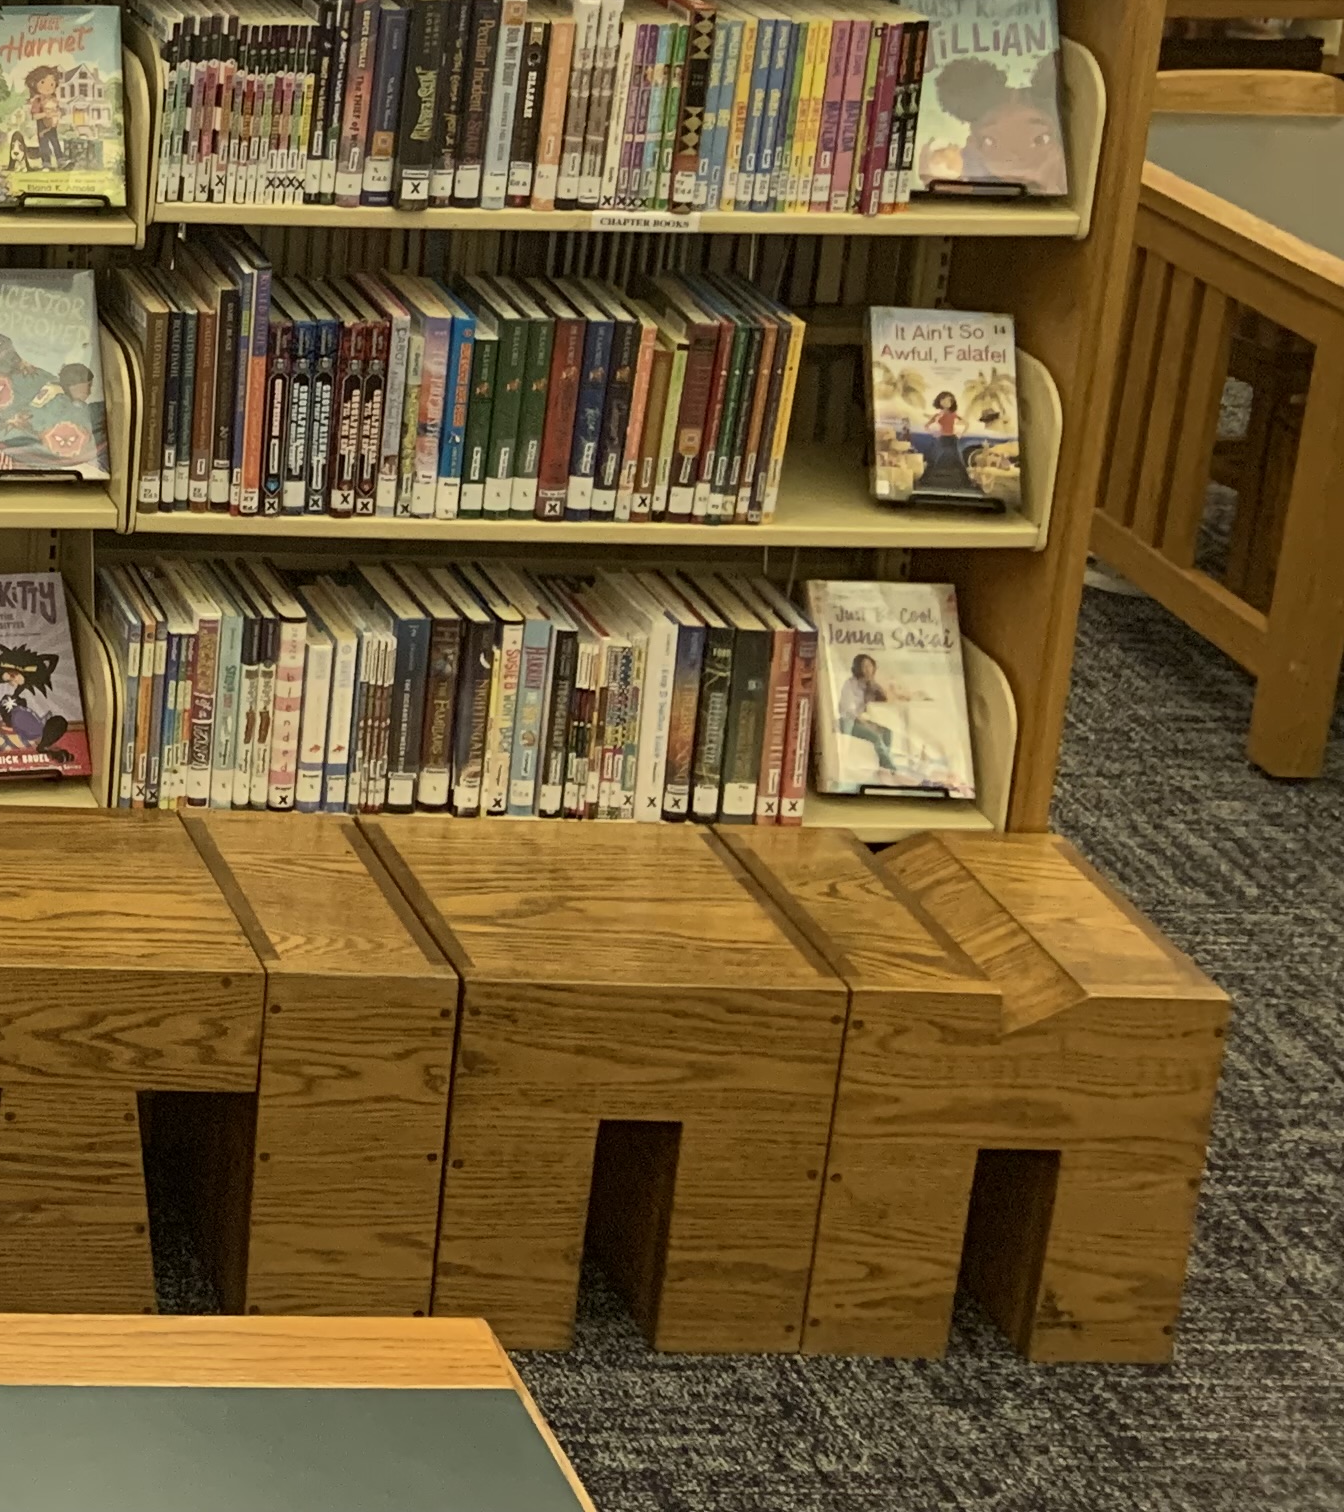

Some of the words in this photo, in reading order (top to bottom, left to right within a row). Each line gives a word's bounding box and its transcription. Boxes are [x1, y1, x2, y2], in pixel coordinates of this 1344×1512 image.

[27, 12, 64, 35] Just
[599, 216, 648, 229] CHAPTER
[649, 217, 690, 230] BOOKS
[895, 323, 906, 341] It
[912, 324, 954, 340] Ain't
[959, 324, 985, 340] So
[881, 343, 938, 364] Awful,
[943, 345, 1007, 364] Falafel
[22, 753, 51, 764] BRUEL
